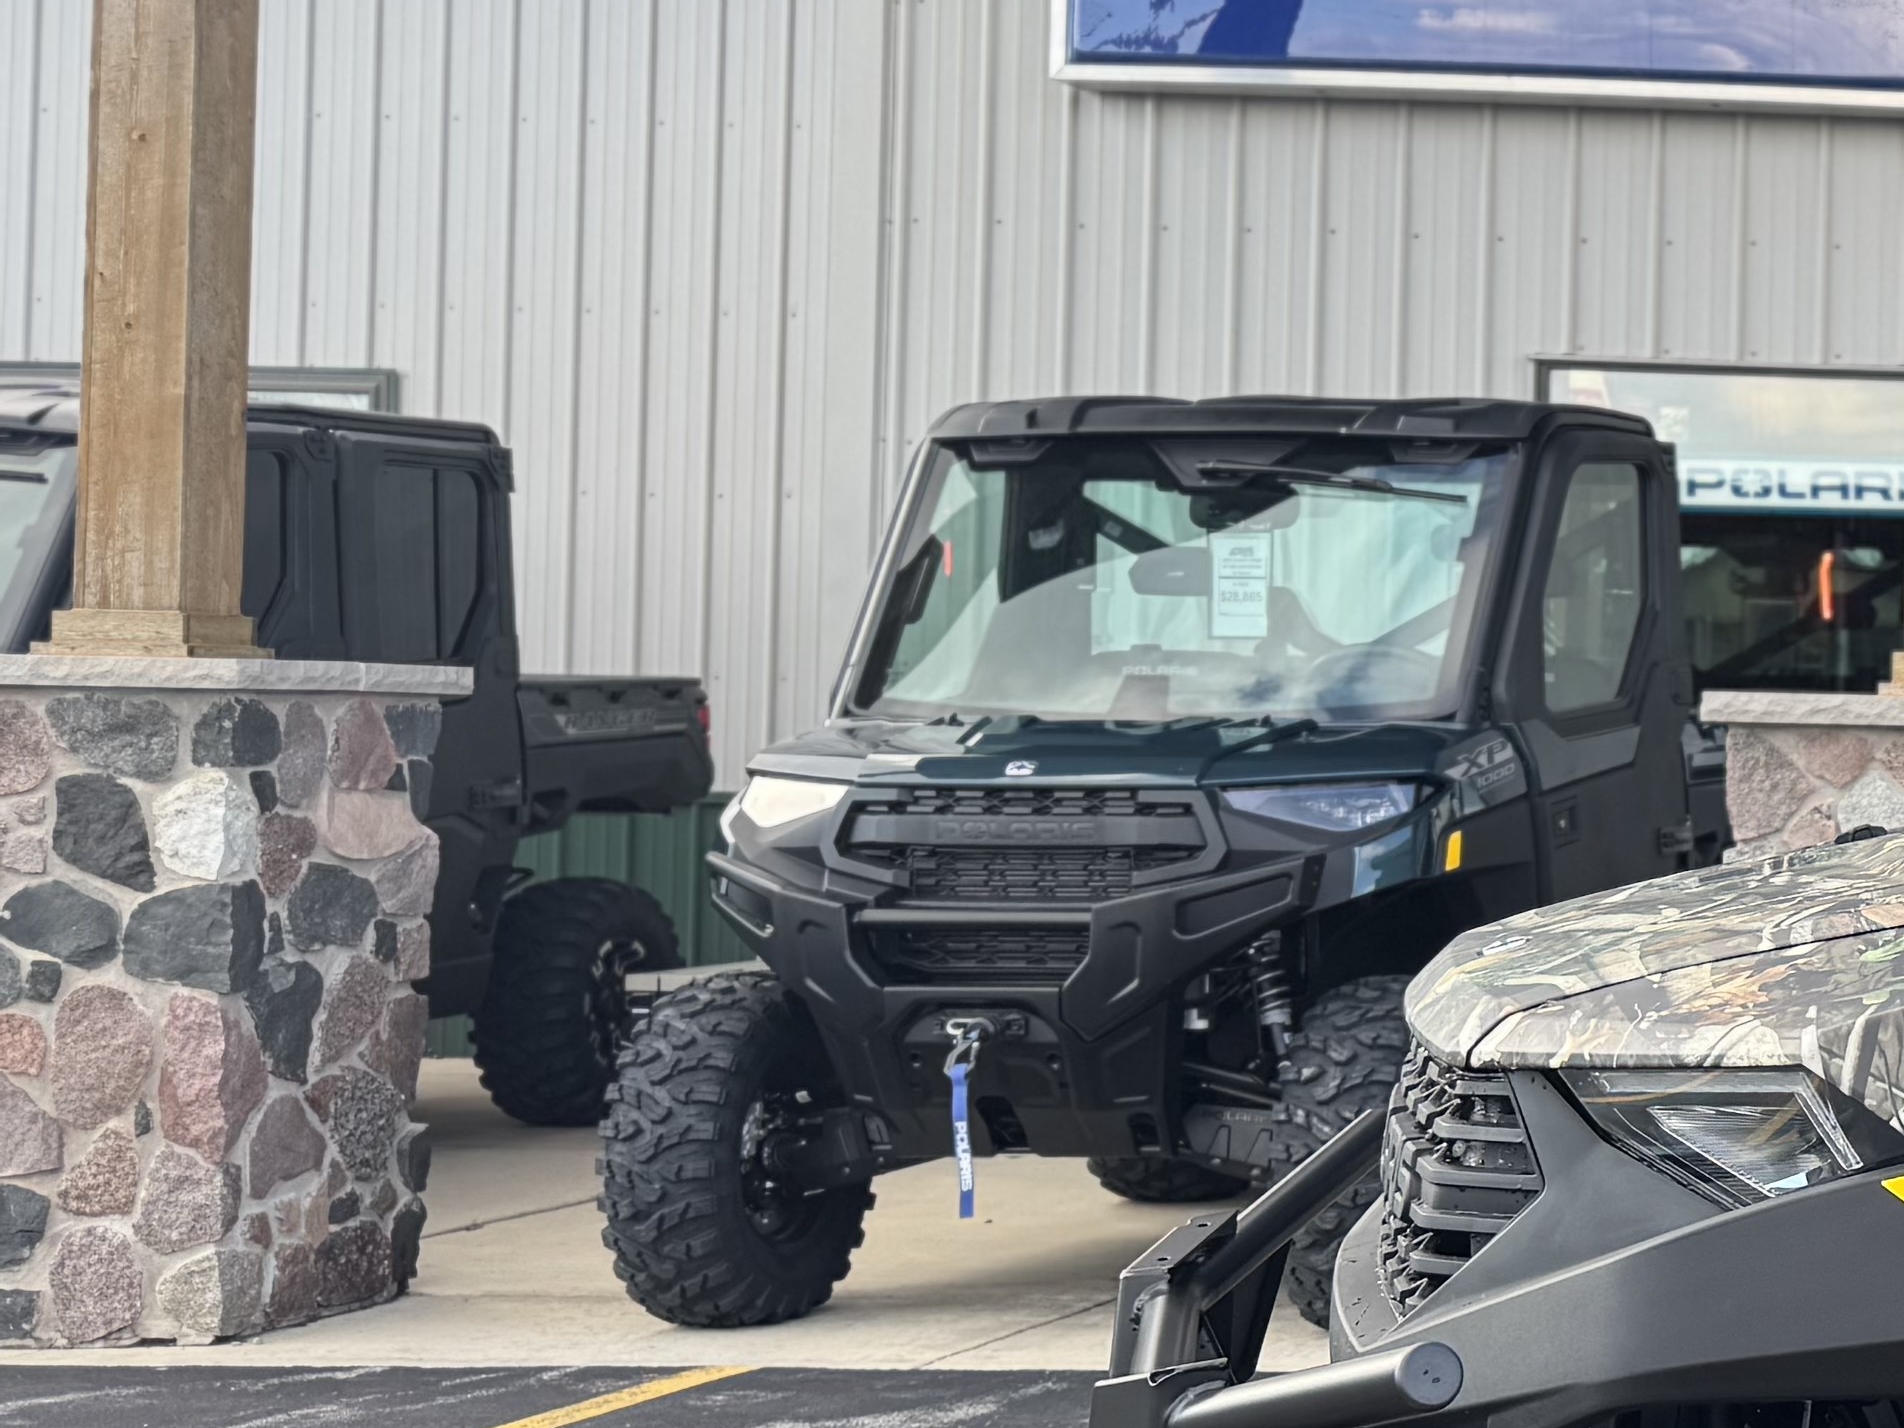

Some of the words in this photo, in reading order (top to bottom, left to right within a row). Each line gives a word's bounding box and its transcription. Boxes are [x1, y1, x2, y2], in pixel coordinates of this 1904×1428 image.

[1459, 737, 1513, 777] XP
[1476, 763, 1516, 787] 1000
[933, 820, 1099, 844] POLARIS
[954, 1121, 973, 1192] POLARIS
